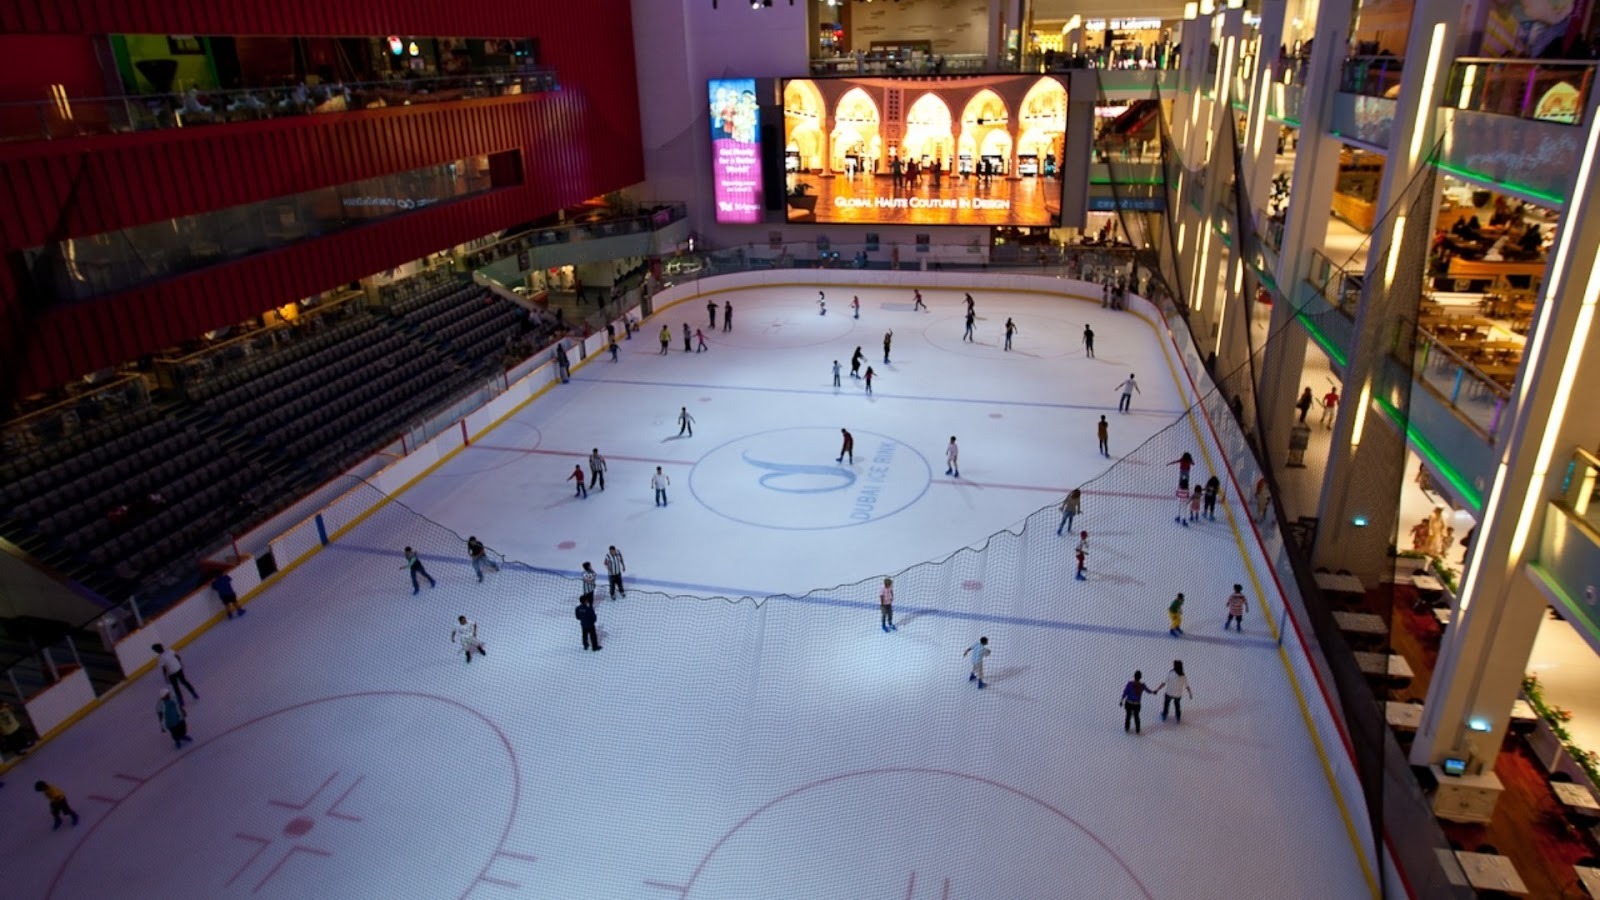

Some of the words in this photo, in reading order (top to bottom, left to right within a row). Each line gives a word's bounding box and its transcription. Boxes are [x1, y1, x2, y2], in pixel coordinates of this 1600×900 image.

[909, 197, 957, 209] COUTURE
[972, 198, 1010, 210] DESIGN
[863, 466, 889, 482] ICE
[849, 485, 881, 520] DUBAI
